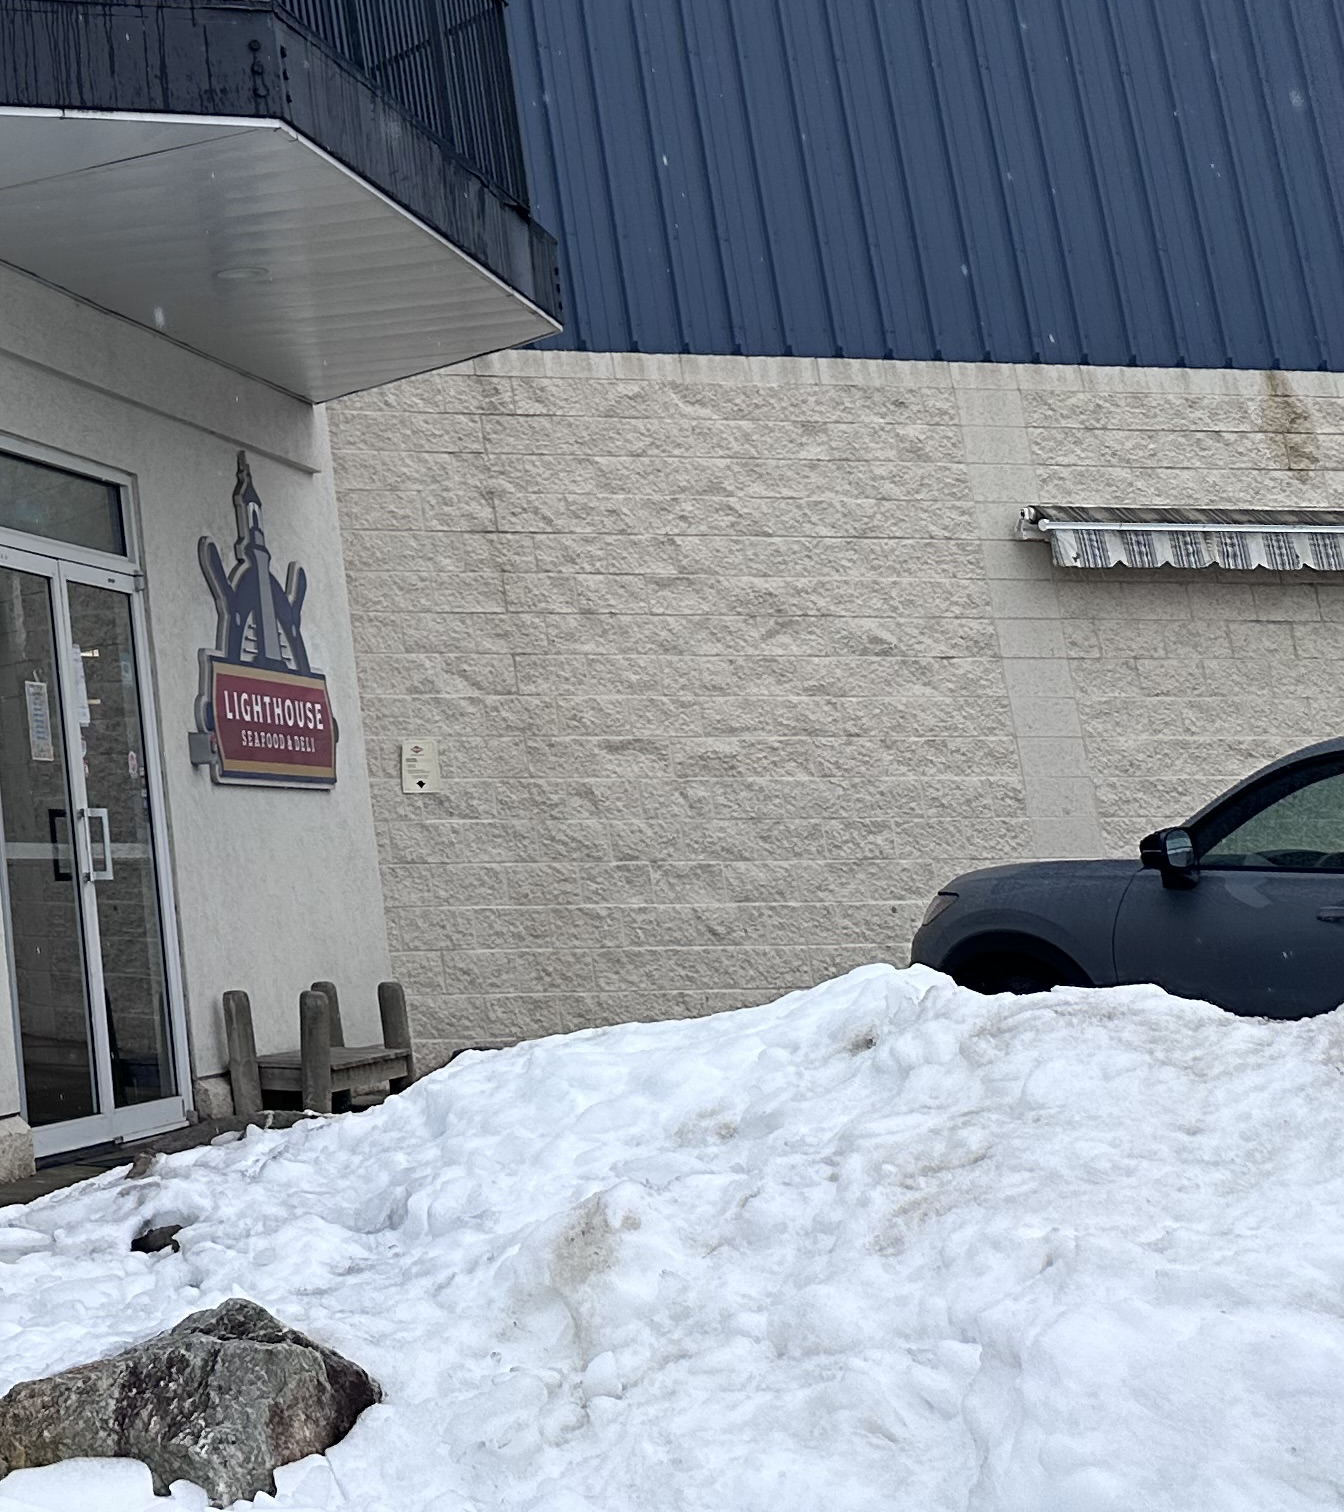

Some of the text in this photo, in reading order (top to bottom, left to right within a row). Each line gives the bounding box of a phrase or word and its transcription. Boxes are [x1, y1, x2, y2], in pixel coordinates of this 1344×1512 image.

[223, 690, 324, 730] LIGHTHOUSE
[241, 729, 316, 752] SEAFOOD & DELI
